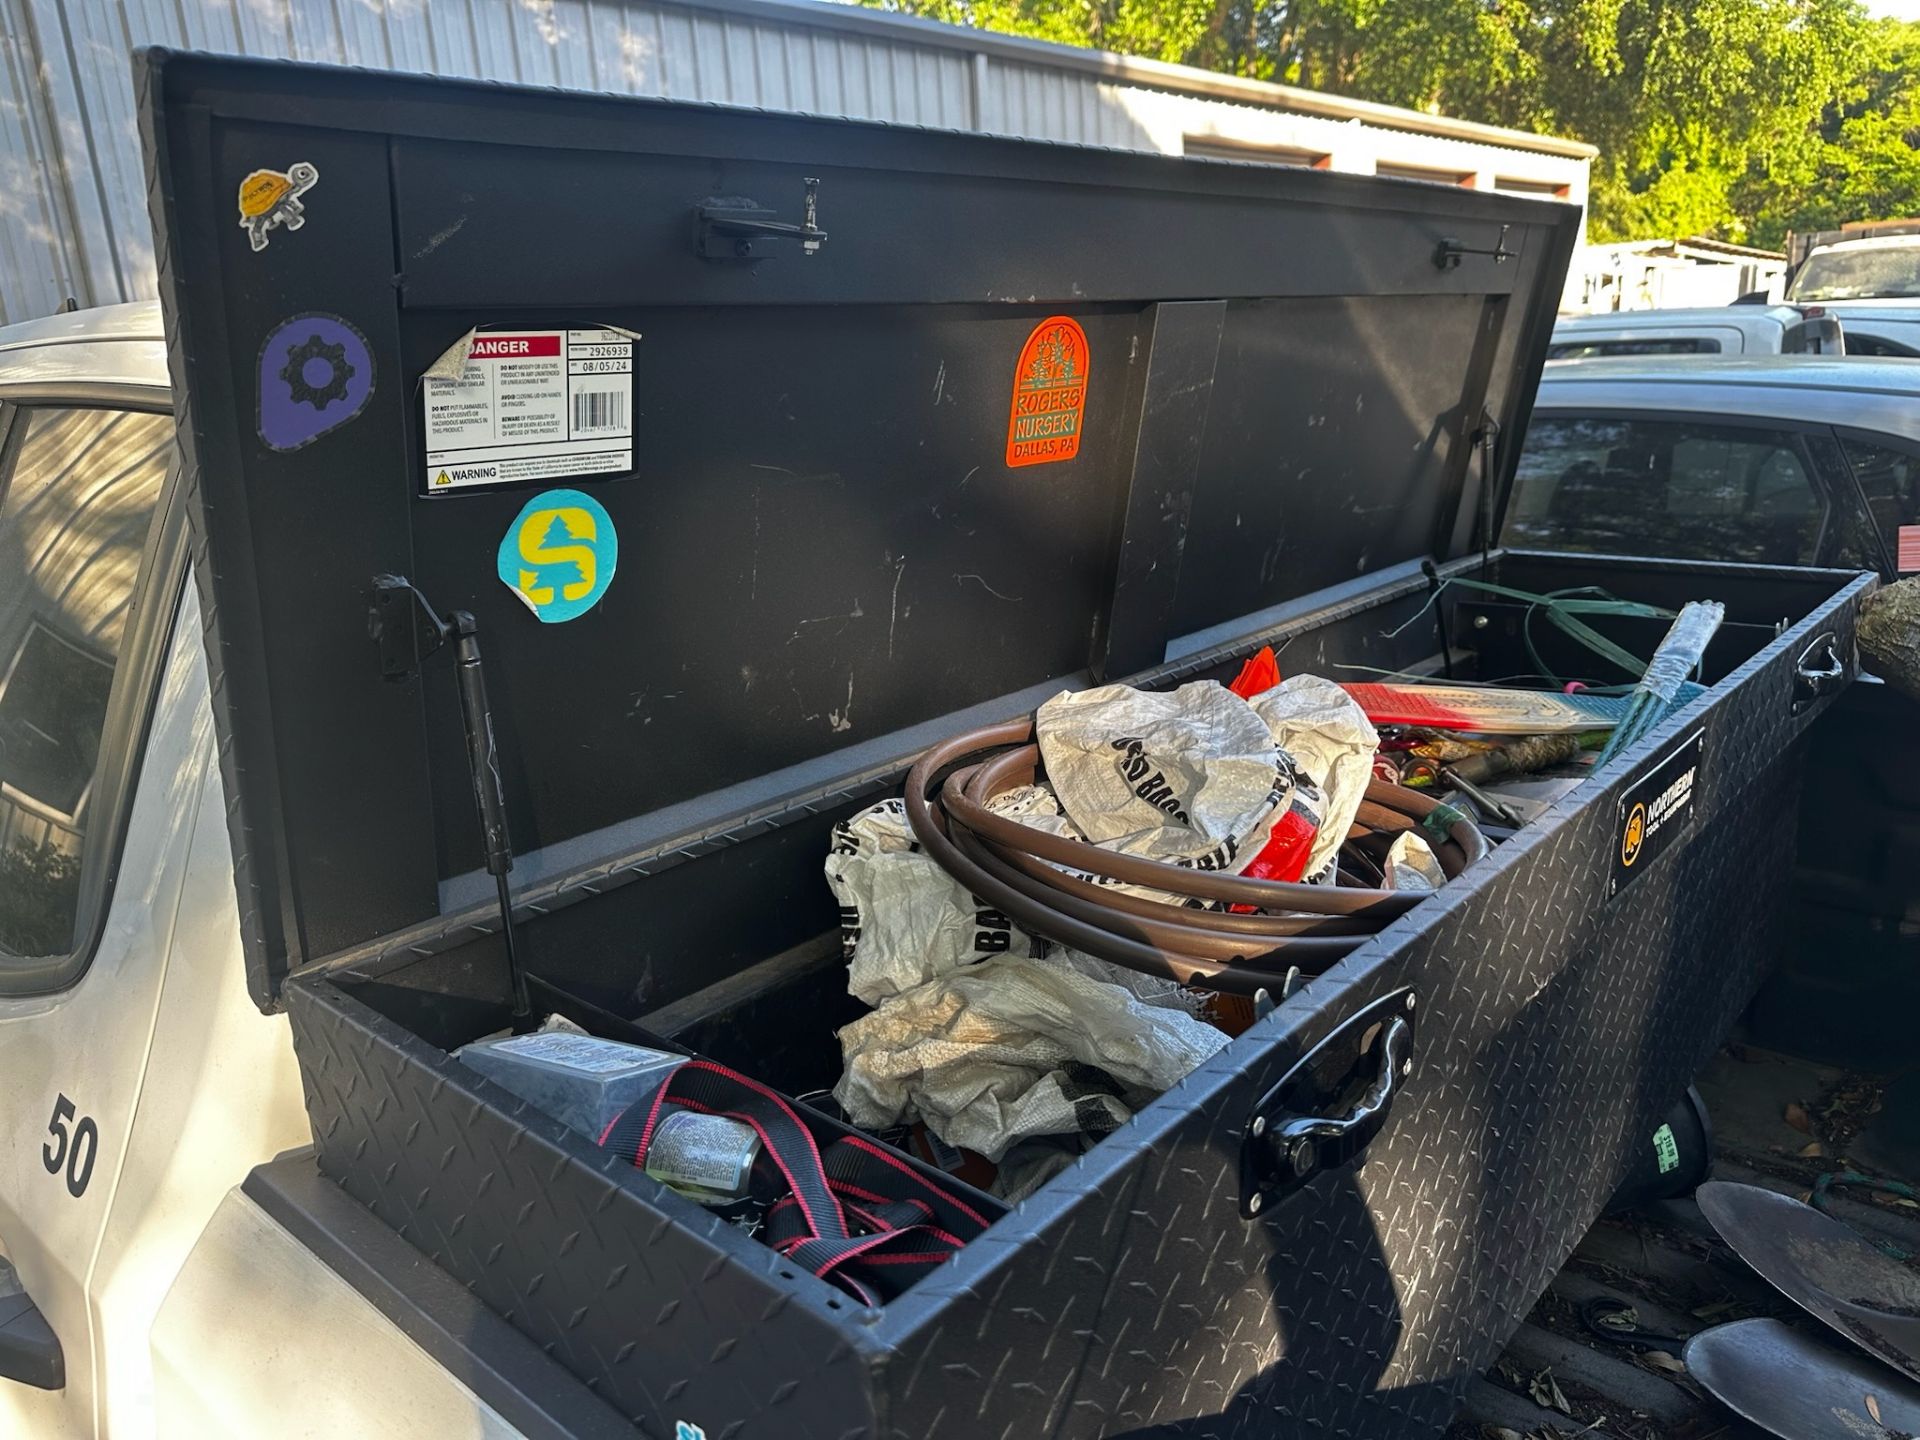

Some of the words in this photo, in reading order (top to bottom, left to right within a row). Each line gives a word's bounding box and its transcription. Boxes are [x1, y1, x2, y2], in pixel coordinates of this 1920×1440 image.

[589, 346, 628, 356] 2926939
[583, 361, 627, 371] 08/05/24
[1016, 412, 1079, 439] NURSERY
[1014, 440, 1057, 458] DALLAS,
[1060, 438, 1074, 452] PA
[452, 467, 496, 480] WARNING
[1646, 766, 1697, 825] NORTHERN
[43, 1092, 98, 1198] 50
